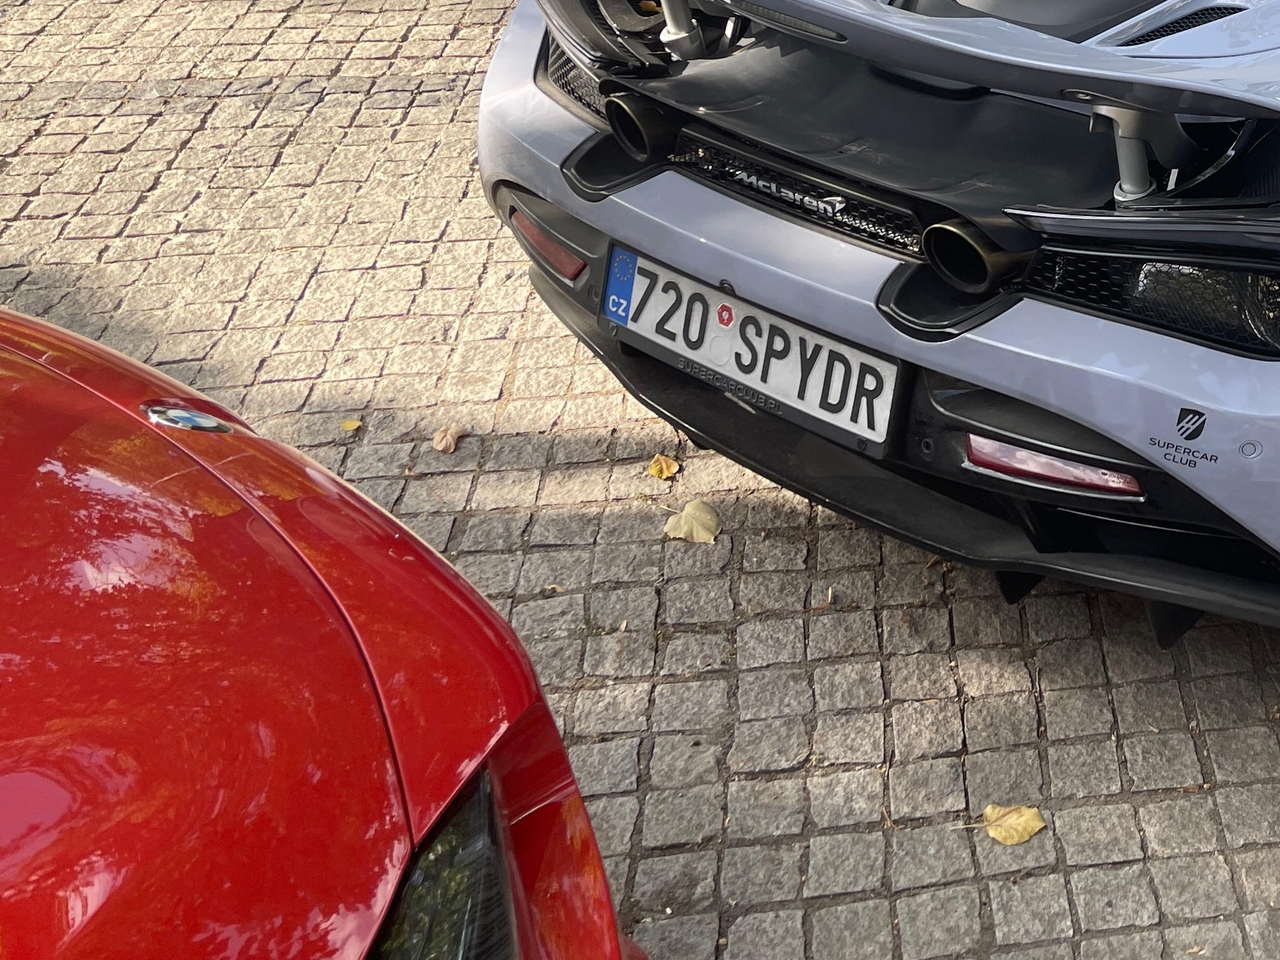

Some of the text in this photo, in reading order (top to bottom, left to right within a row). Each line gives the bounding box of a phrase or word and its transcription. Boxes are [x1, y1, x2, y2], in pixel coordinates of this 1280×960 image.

[735, 171, 835, 217] McLaren
[608, 294, 628, 317] CZ
[630, 266, 884, 431] 720 SPYDR
[677, 357, 783, 415] SUPERCARCLUB.PL
[1148, 437, 1219, 464] SUPERCAR
[1163, 452, 1197, 468] CLUB
